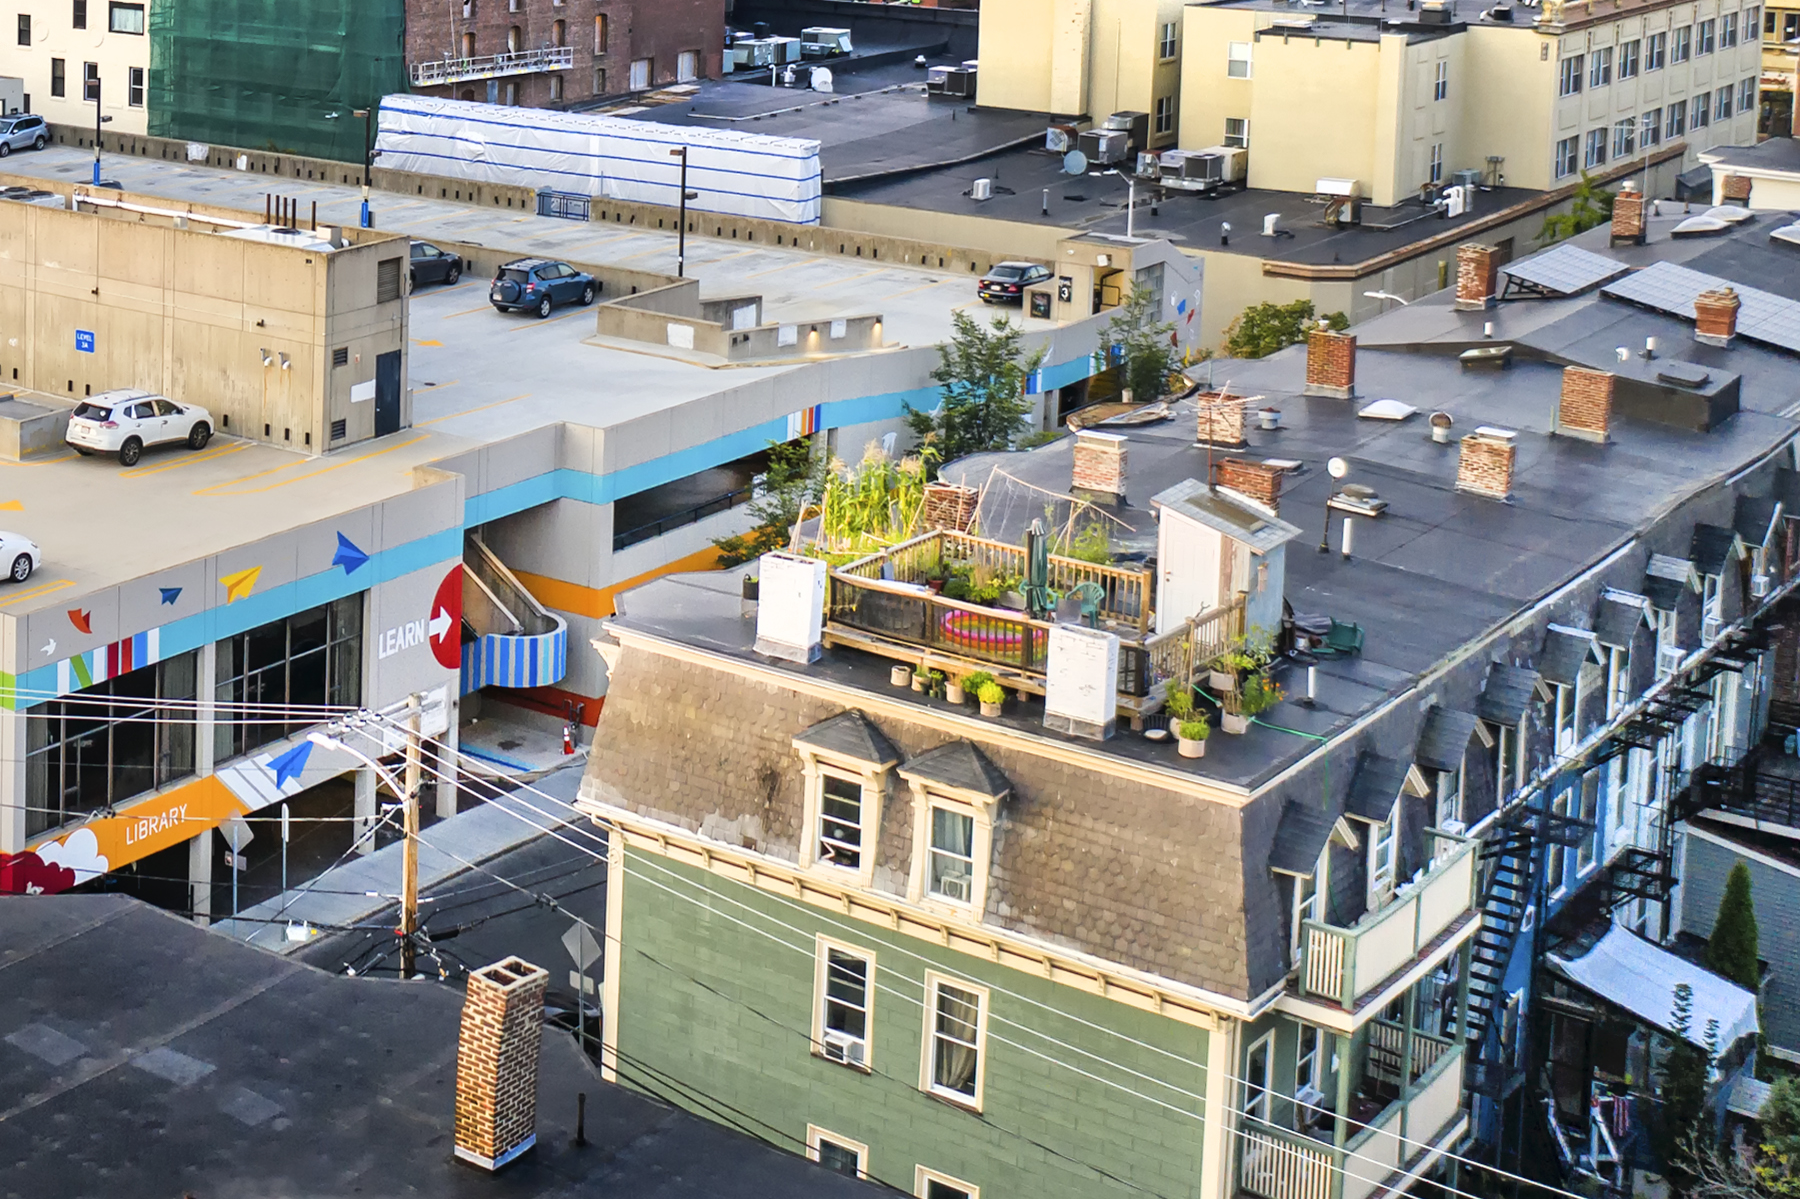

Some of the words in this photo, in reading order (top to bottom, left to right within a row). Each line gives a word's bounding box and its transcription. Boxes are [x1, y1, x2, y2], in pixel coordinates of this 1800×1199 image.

[1061, 287, 1069, 300] 3
[379, 618, 425, 660] LEARN
[126, 803, 188, 845] LIBRARY
